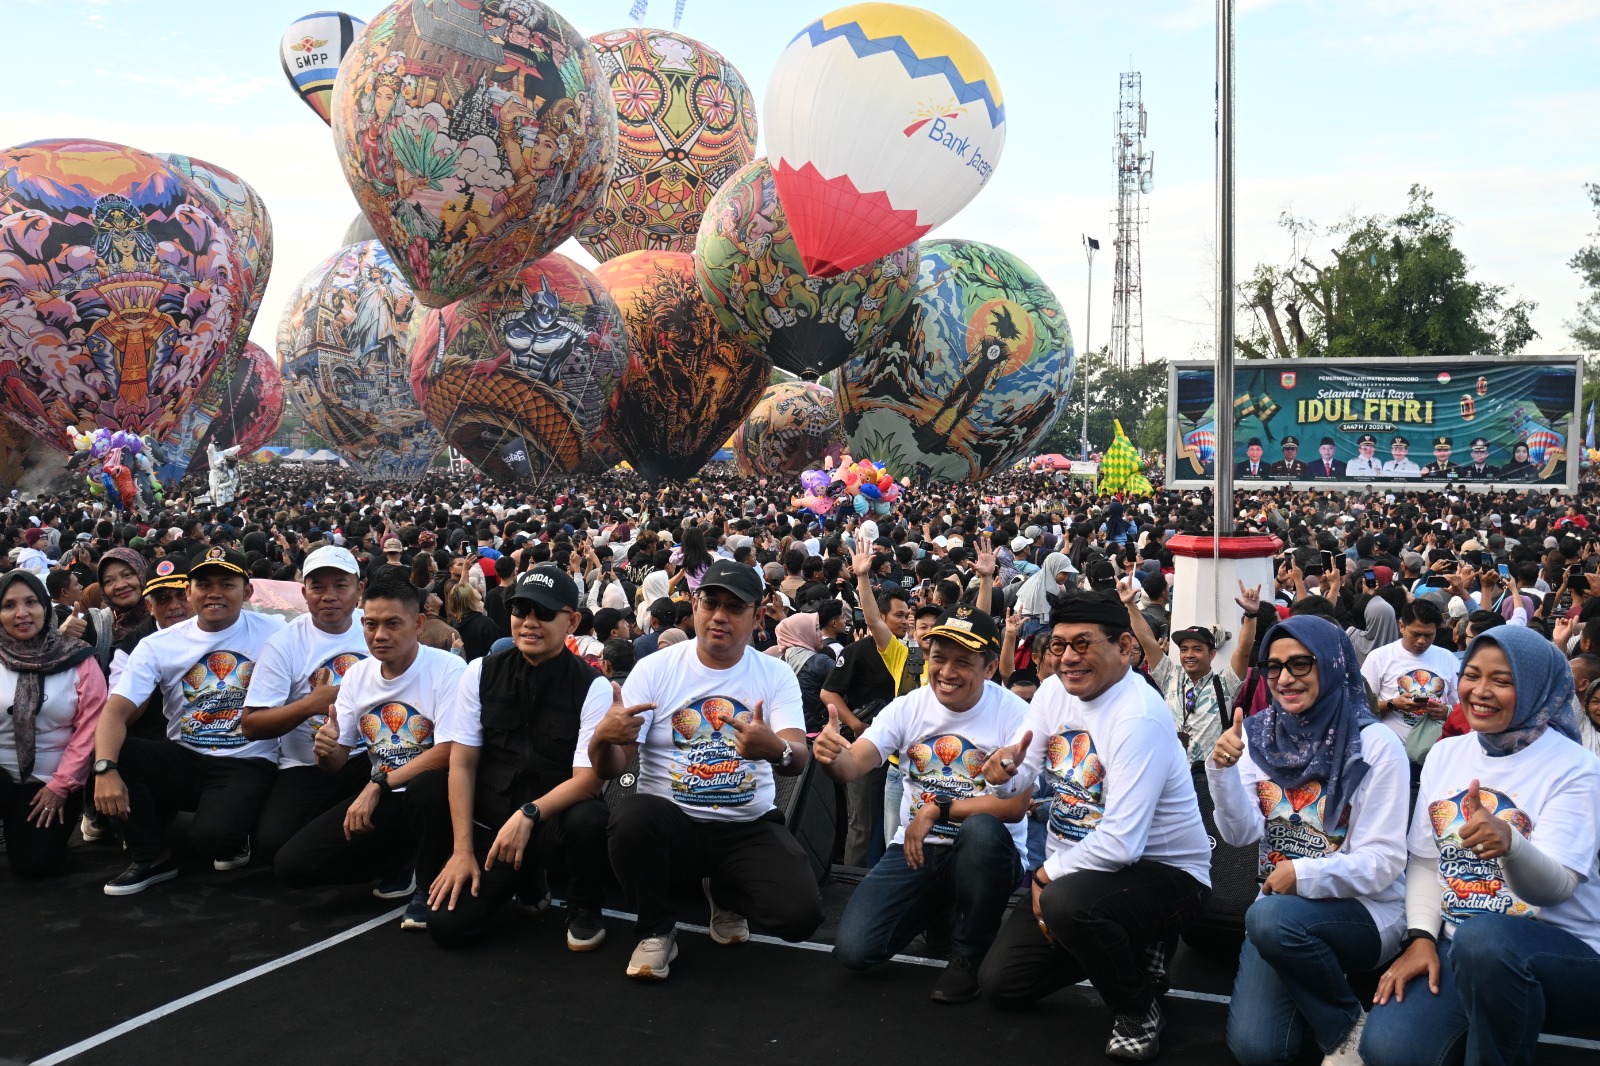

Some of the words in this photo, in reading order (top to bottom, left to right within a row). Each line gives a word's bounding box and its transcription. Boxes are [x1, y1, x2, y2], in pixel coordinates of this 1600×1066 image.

[296, 53, 328, 68] GMPP
[928, 117, 971, 158] Bank
[1317, 388, 1361, 399] Selamat
[1361, 388, 1385, 399] Hari
[1387, 388, 1415, 400] Raya
[1298, 399, 1358, 423] IDUL
[1364, 399, 1433, 424] FITRI
[522, 573, 554, 588] ADIDAS
[198, 700, 242, 710] Berkarya
[192, 709, 238, 723] Kreatif
[689, 749, 741, 763] Berkary
[687, 760, 739, 778] Kreatif
[683, 771, 745, 788] Produktif
[924, 777, 973, 791] Berdaya
[1269, 825, 1325, 850] Berdaya
[1268, 838, 1324, 859] Berkarya
[1440, 860, 1503, 880] Berkarya
[1446, 877, 1501, 898] Kreatif
[1444, 890, 1511, 914] Produktif
